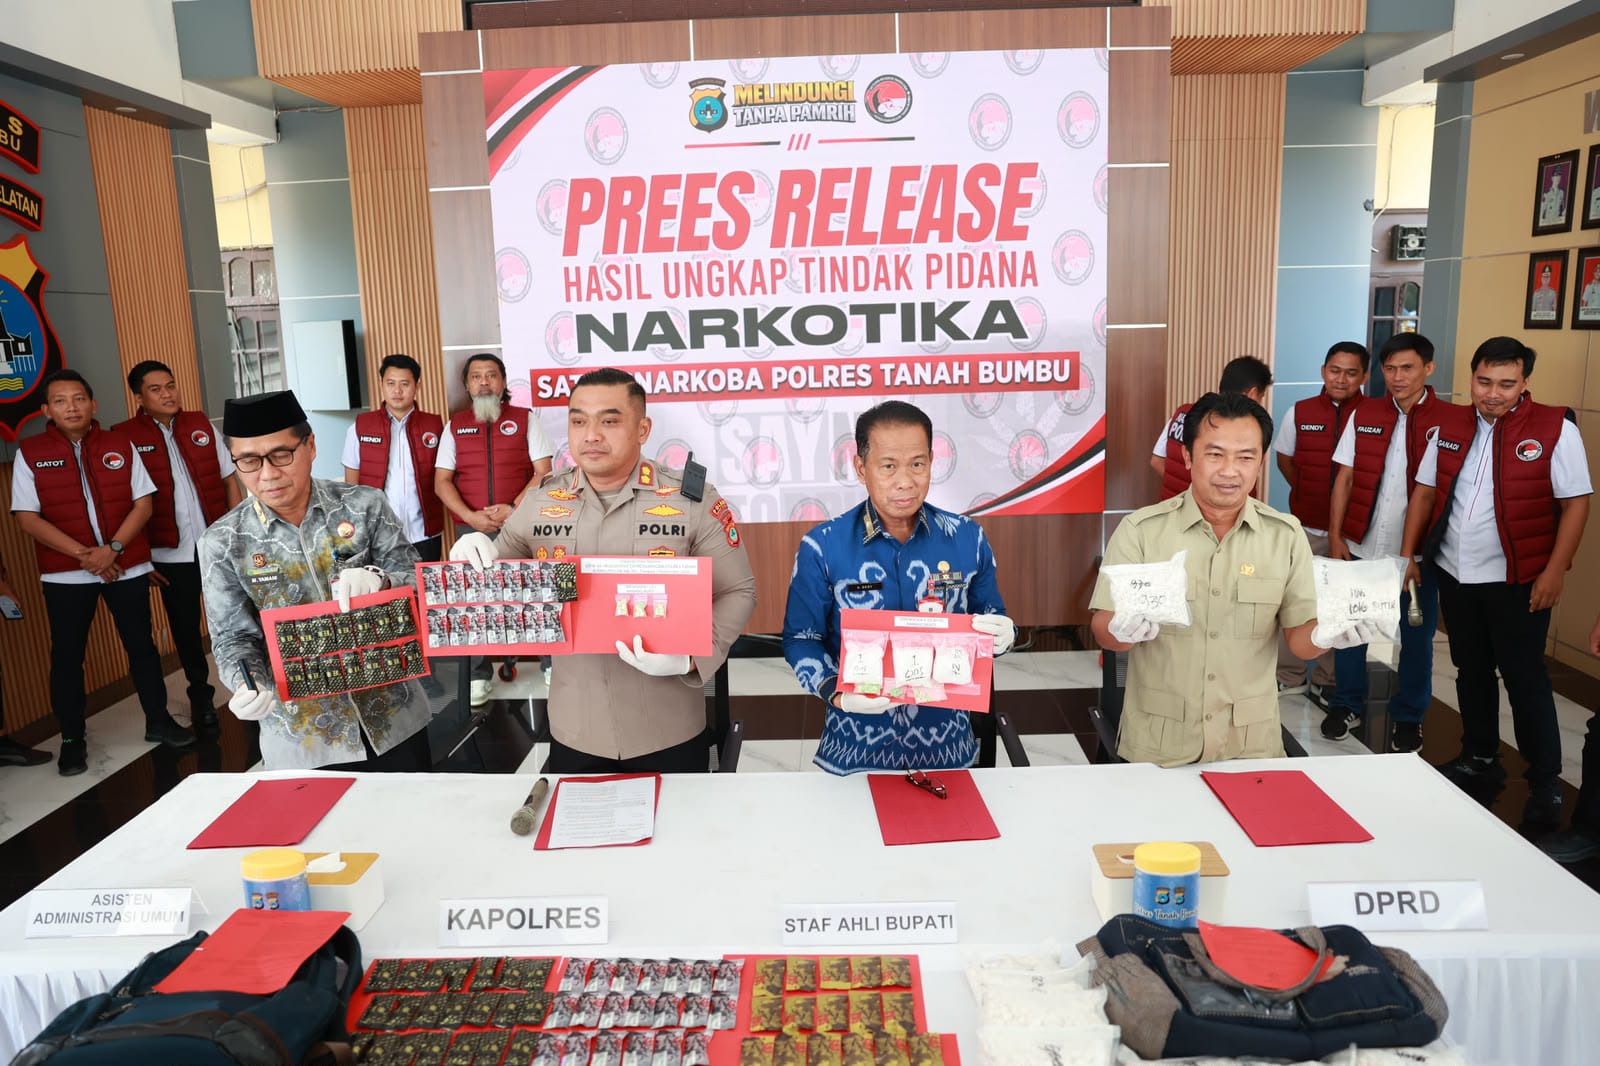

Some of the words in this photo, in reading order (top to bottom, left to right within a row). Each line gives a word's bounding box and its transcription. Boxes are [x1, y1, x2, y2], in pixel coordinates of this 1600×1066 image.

[734, 80, 856, 106] MELINDUNGI
[734, 104, 789, 127] TANPA
[790, 103, 856, 123] PAMRIH
[563, 171, 758, 257] PREES
[770, 161, 1040, 249] RELEASE
[565, 263, 652, 304] HASIL
[664, 257, 788, 300] UNGKAP
[800, 253, 913, 294] TINDAK
[926, 249, 1038, 290] PIDANA
[575, 299, 1029, 355] NARKOTIKA
[773, 363, 872, 391] POLRES
[879, 360, 970, 388] TANAH
[979, 358, 1071, 385] BUMBU
[36, 460, 65, 468] GATOT
[533, 525, 573, 537] NOVY
[639, 523, 686, 537] POLRI
[91, 893, 153, 907] ASISTEN
[1354, 889, 1440, 917] DPRD
[33, 910, 137, 925] ADMINISTRASI
[141, 909, 185, 924] UMUM
[447, 906, 601, 931] KAPOLRES
[785, 918, 831, 934] STAF
[838, 916, 880, 932] AHLI
[886, 914, 953, 931] BUPATI
